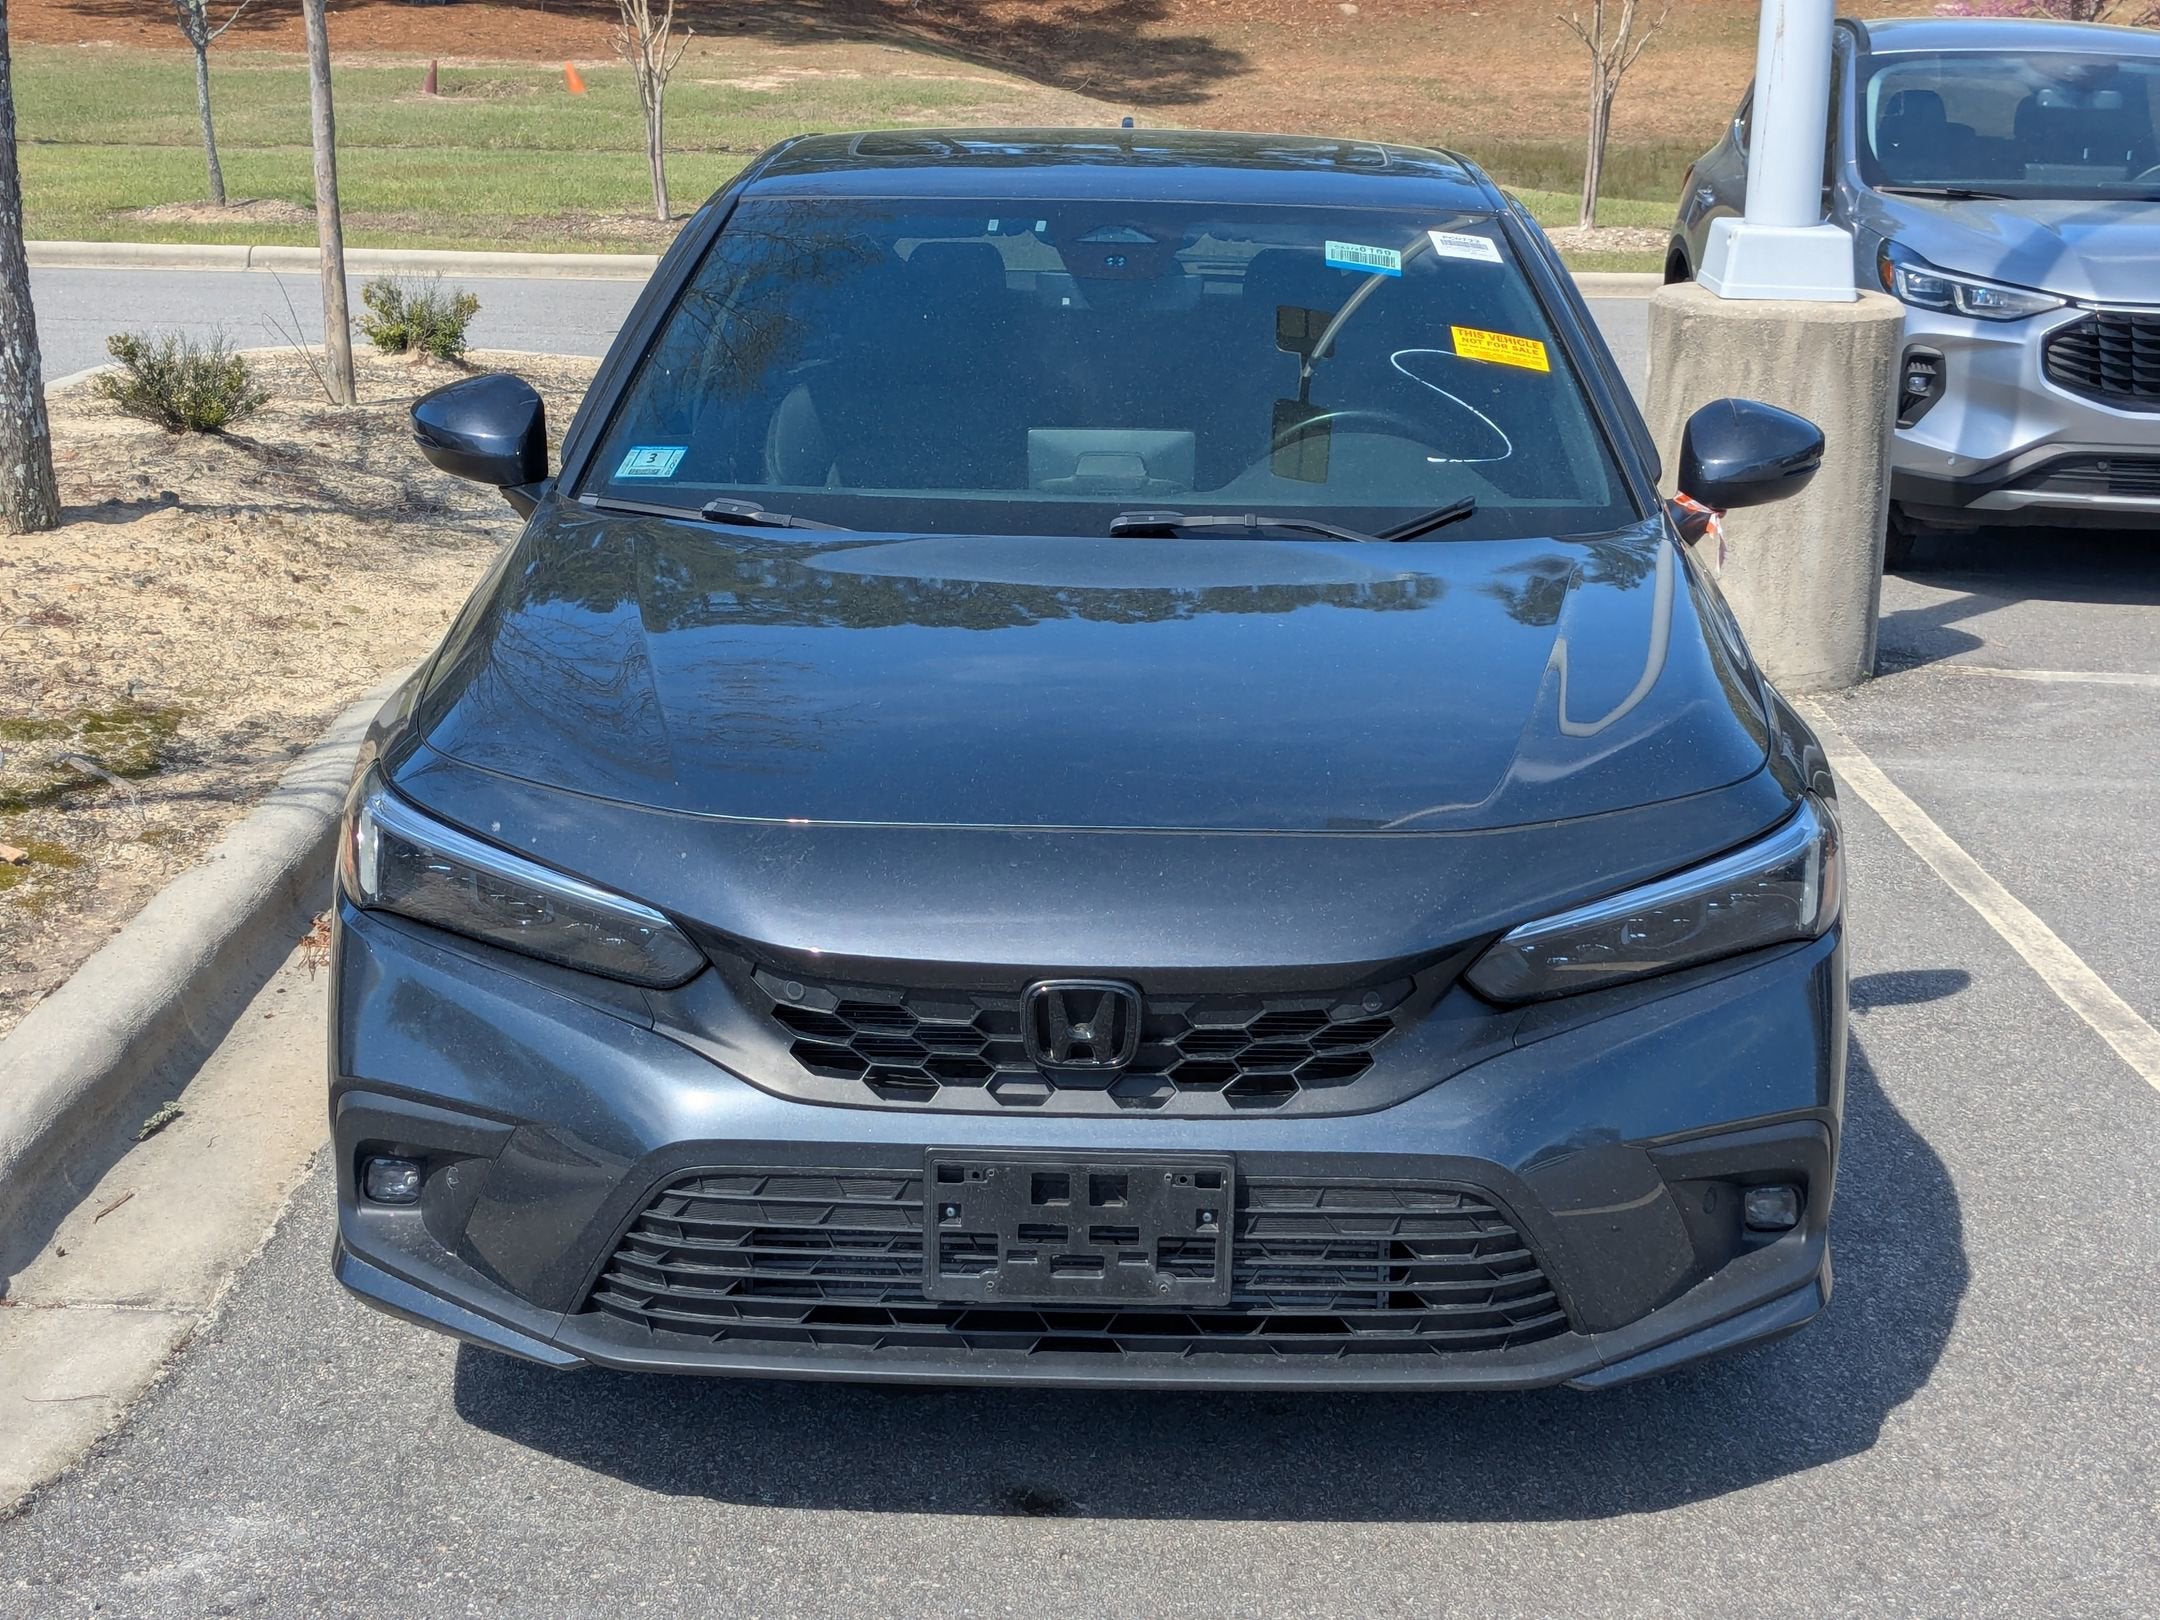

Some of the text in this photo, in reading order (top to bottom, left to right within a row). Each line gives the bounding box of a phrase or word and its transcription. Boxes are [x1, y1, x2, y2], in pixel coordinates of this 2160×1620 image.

[1456, 329, 1541, 350] THIS VEHICLE
[1461, 337, 1483, 345] NOT
[1486, 341, 1508, 350] FOR
[1512, 345, 1540, 356] SALE
[646, 453, 658, 464] 3
